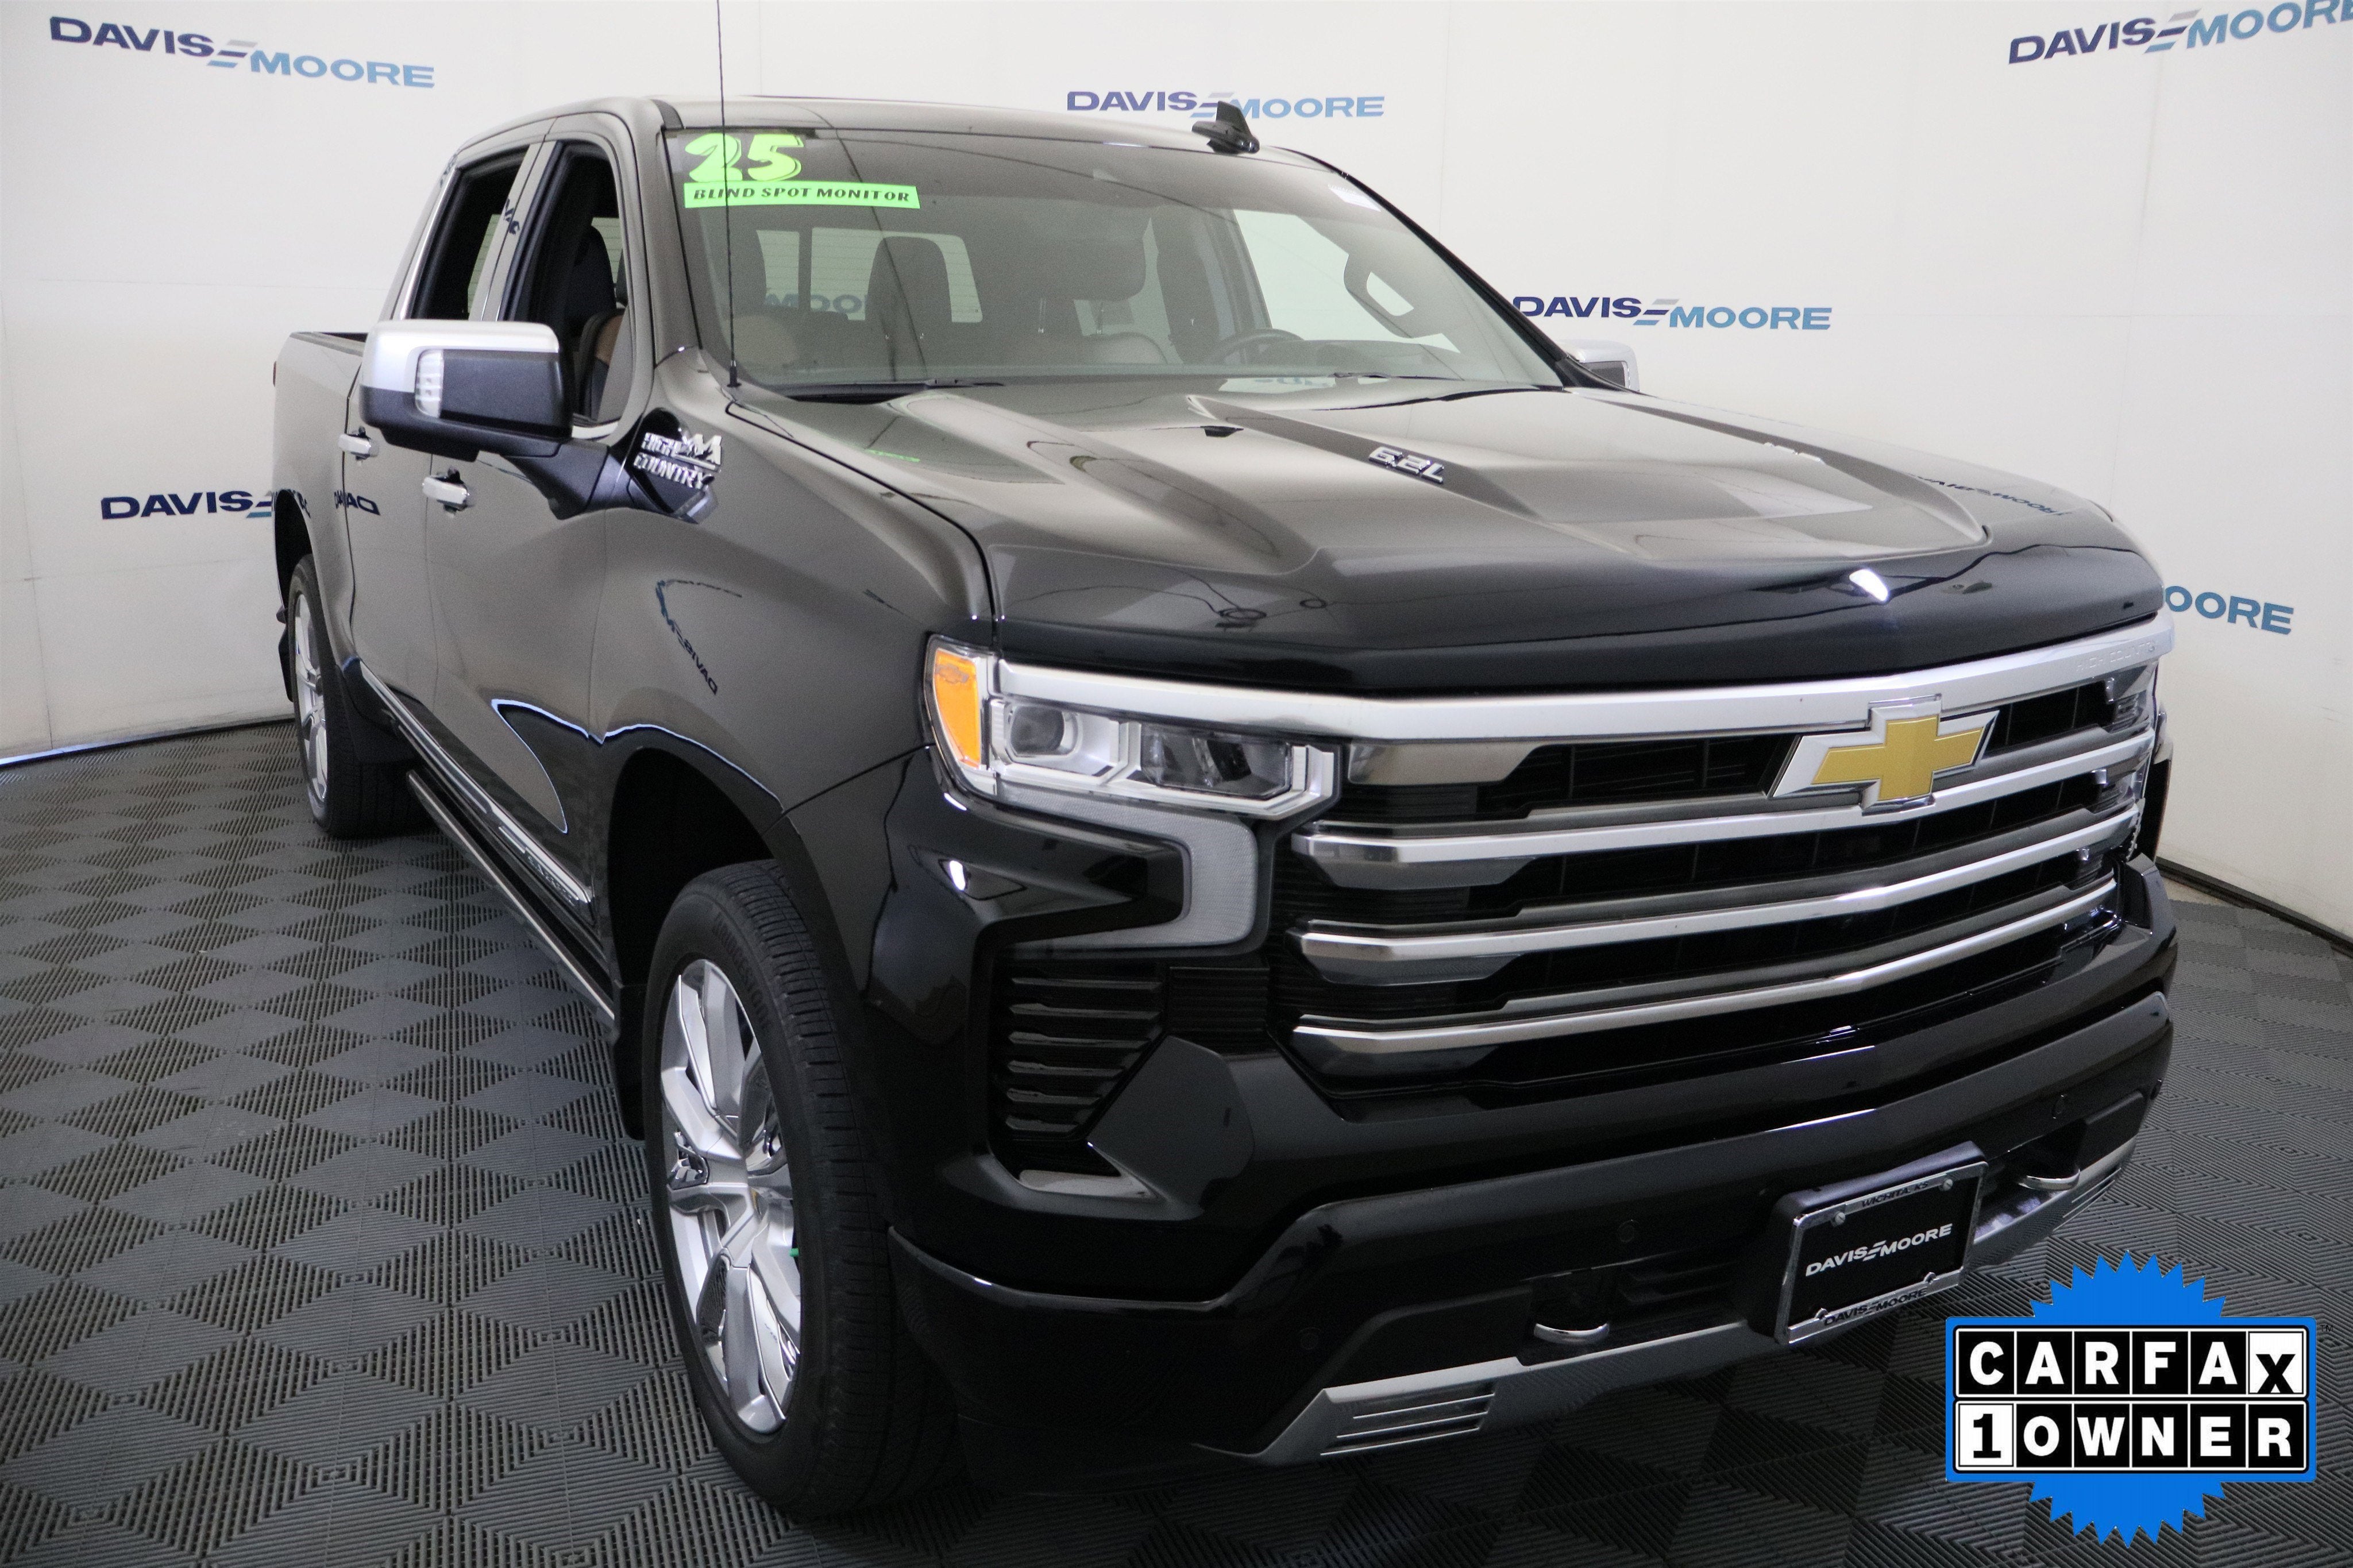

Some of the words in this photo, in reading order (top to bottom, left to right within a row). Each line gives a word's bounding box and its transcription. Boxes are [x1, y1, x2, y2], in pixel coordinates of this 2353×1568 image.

[49, 16, 215, 57] DAVIS
[250, 50, 435, 88] MOORE
[2008, 17, 2157, 65] DAVIS
[1067, 91, 1198, 111] DAVIS
[1229, 96, 1385, 118] MOORE
[685, 133, 804, 183] 25
[693, 187, 756, 200] BLIND
[761, 187, 812, 198] SPOT
[816, 188, 909, 202] MONITOR
[1513, 296, 1642, 319] DAVIS
[1669, 306, 1833, 330] MOORE
[633, 451, 712, 489] COUNTRY
[1368, 446, 1444, 484] 6.2L
[100, 490, 254, 520] DAVIS
[1806, 1246, 1868, 1276] DAVIS
[1880, 1223, 1953, 1257] MOORE
[1824, 1304, 1868, 1326] DAVIS
[1875, 1286, 1928, 1312] MOORE
